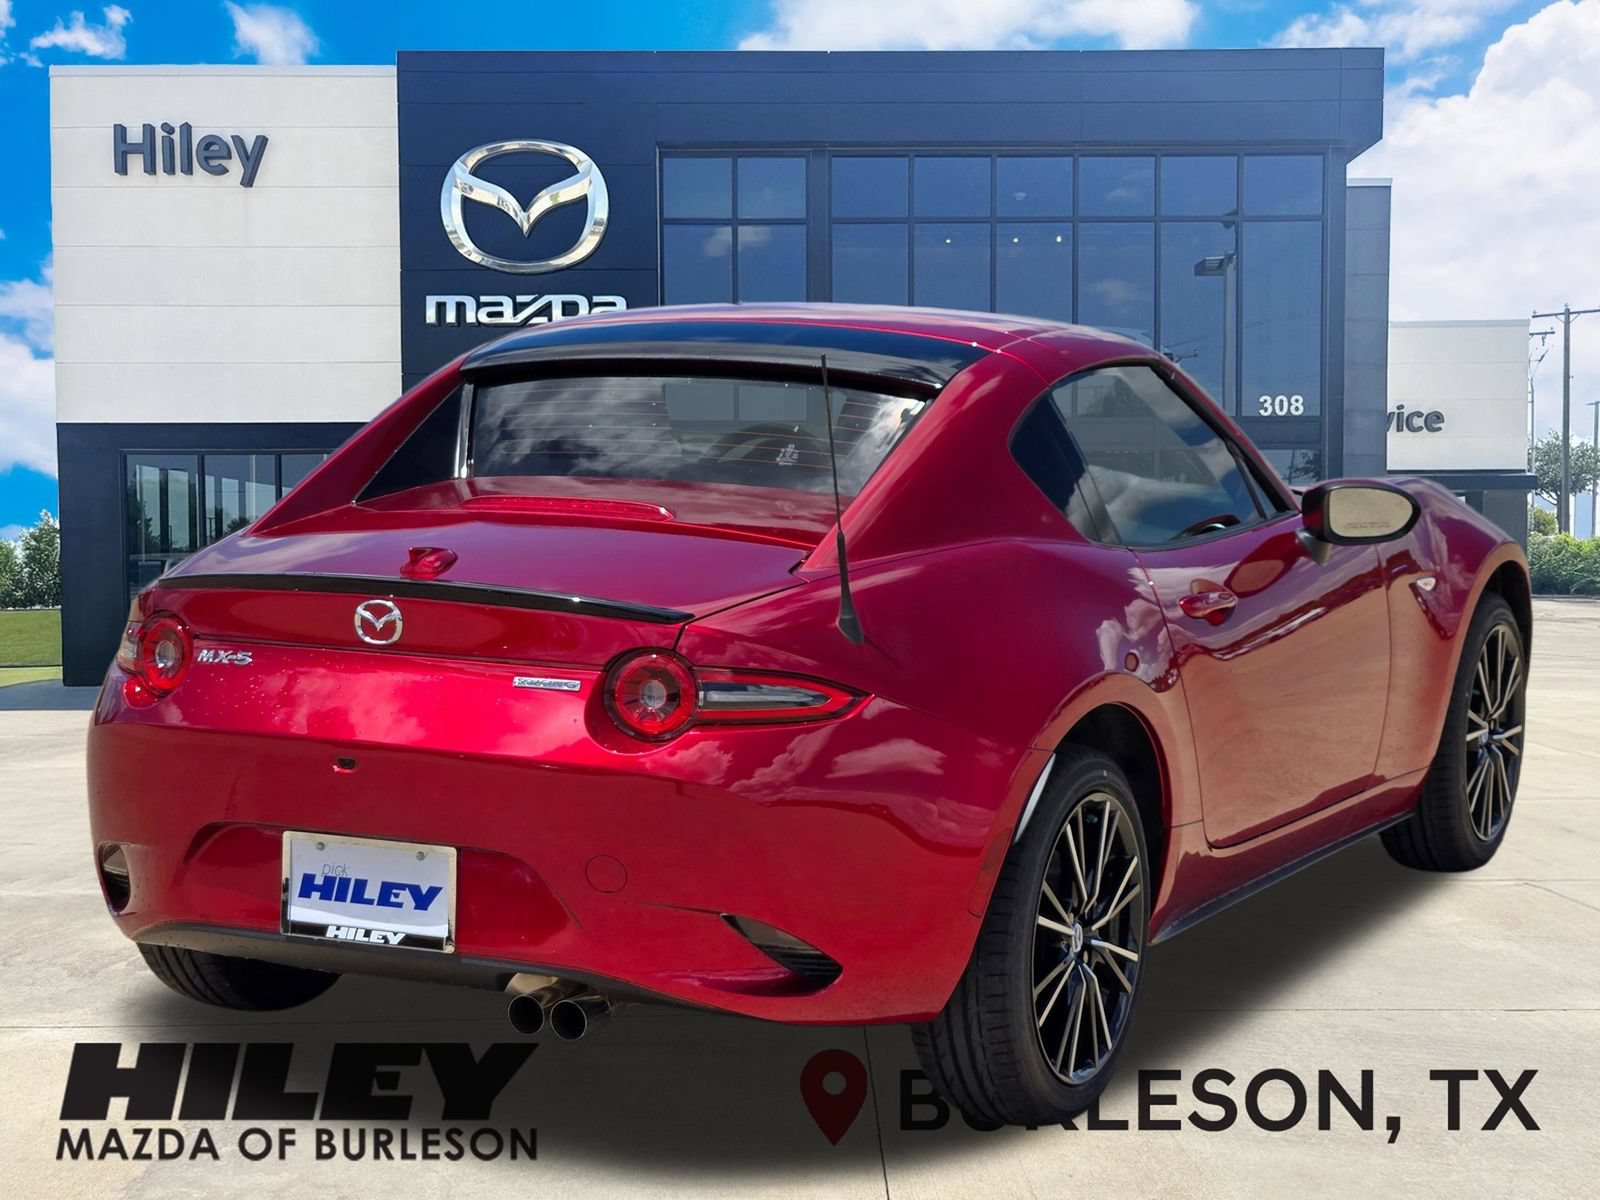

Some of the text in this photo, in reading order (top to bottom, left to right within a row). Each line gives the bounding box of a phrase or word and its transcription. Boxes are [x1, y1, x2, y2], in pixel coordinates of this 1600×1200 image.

[113, 121, 269, 188] Hiley
[1259, 395, 1304, 416] 308
[197, 649, 253, 665] MX-5
[321, 862, 350, 877] pick
[298, 873, 444, 911] HILEY
[325, 925, 406, 945] HILEY
